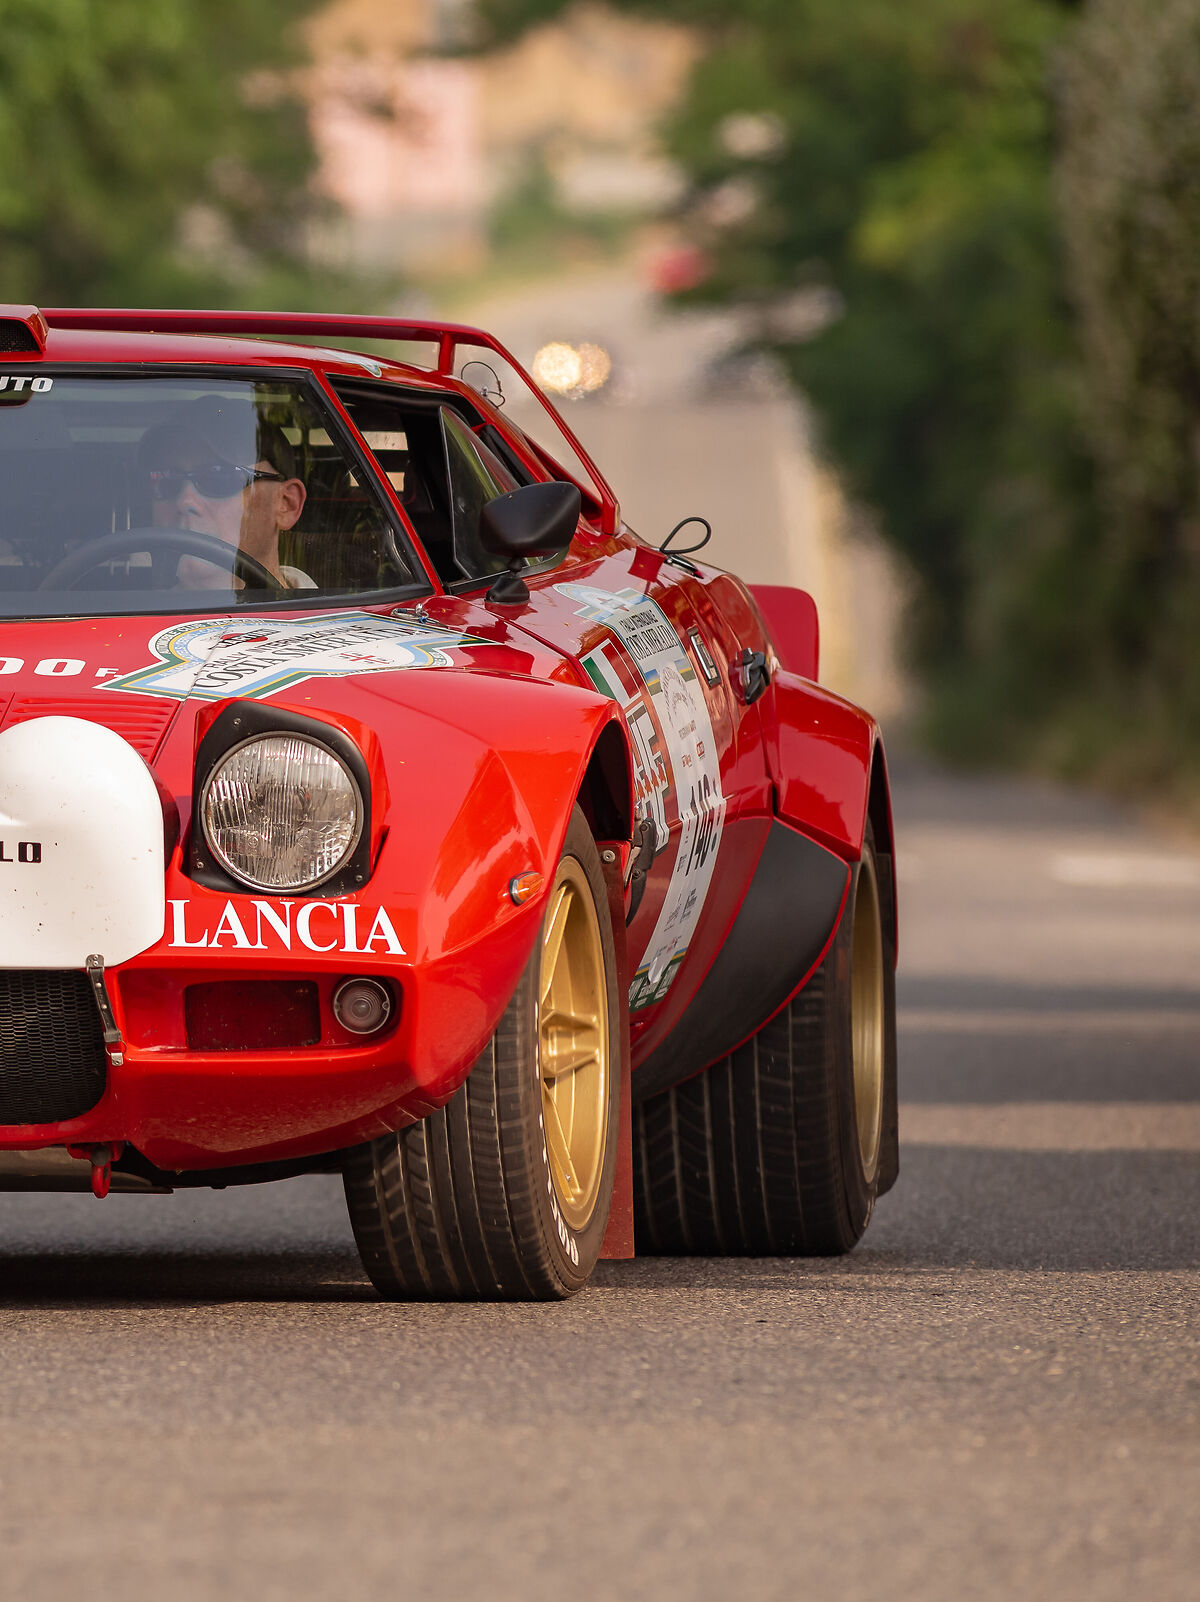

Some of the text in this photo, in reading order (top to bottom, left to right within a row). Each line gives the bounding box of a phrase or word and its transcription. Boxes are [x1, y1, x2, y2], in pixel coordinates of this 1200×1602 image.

[194, 656, 291, 688] COSTA
[271, 627, 431, 664] SMERALDA
[203, 652, 252, 669] RALLY
[168, 900, 407, 955] LANCIA
